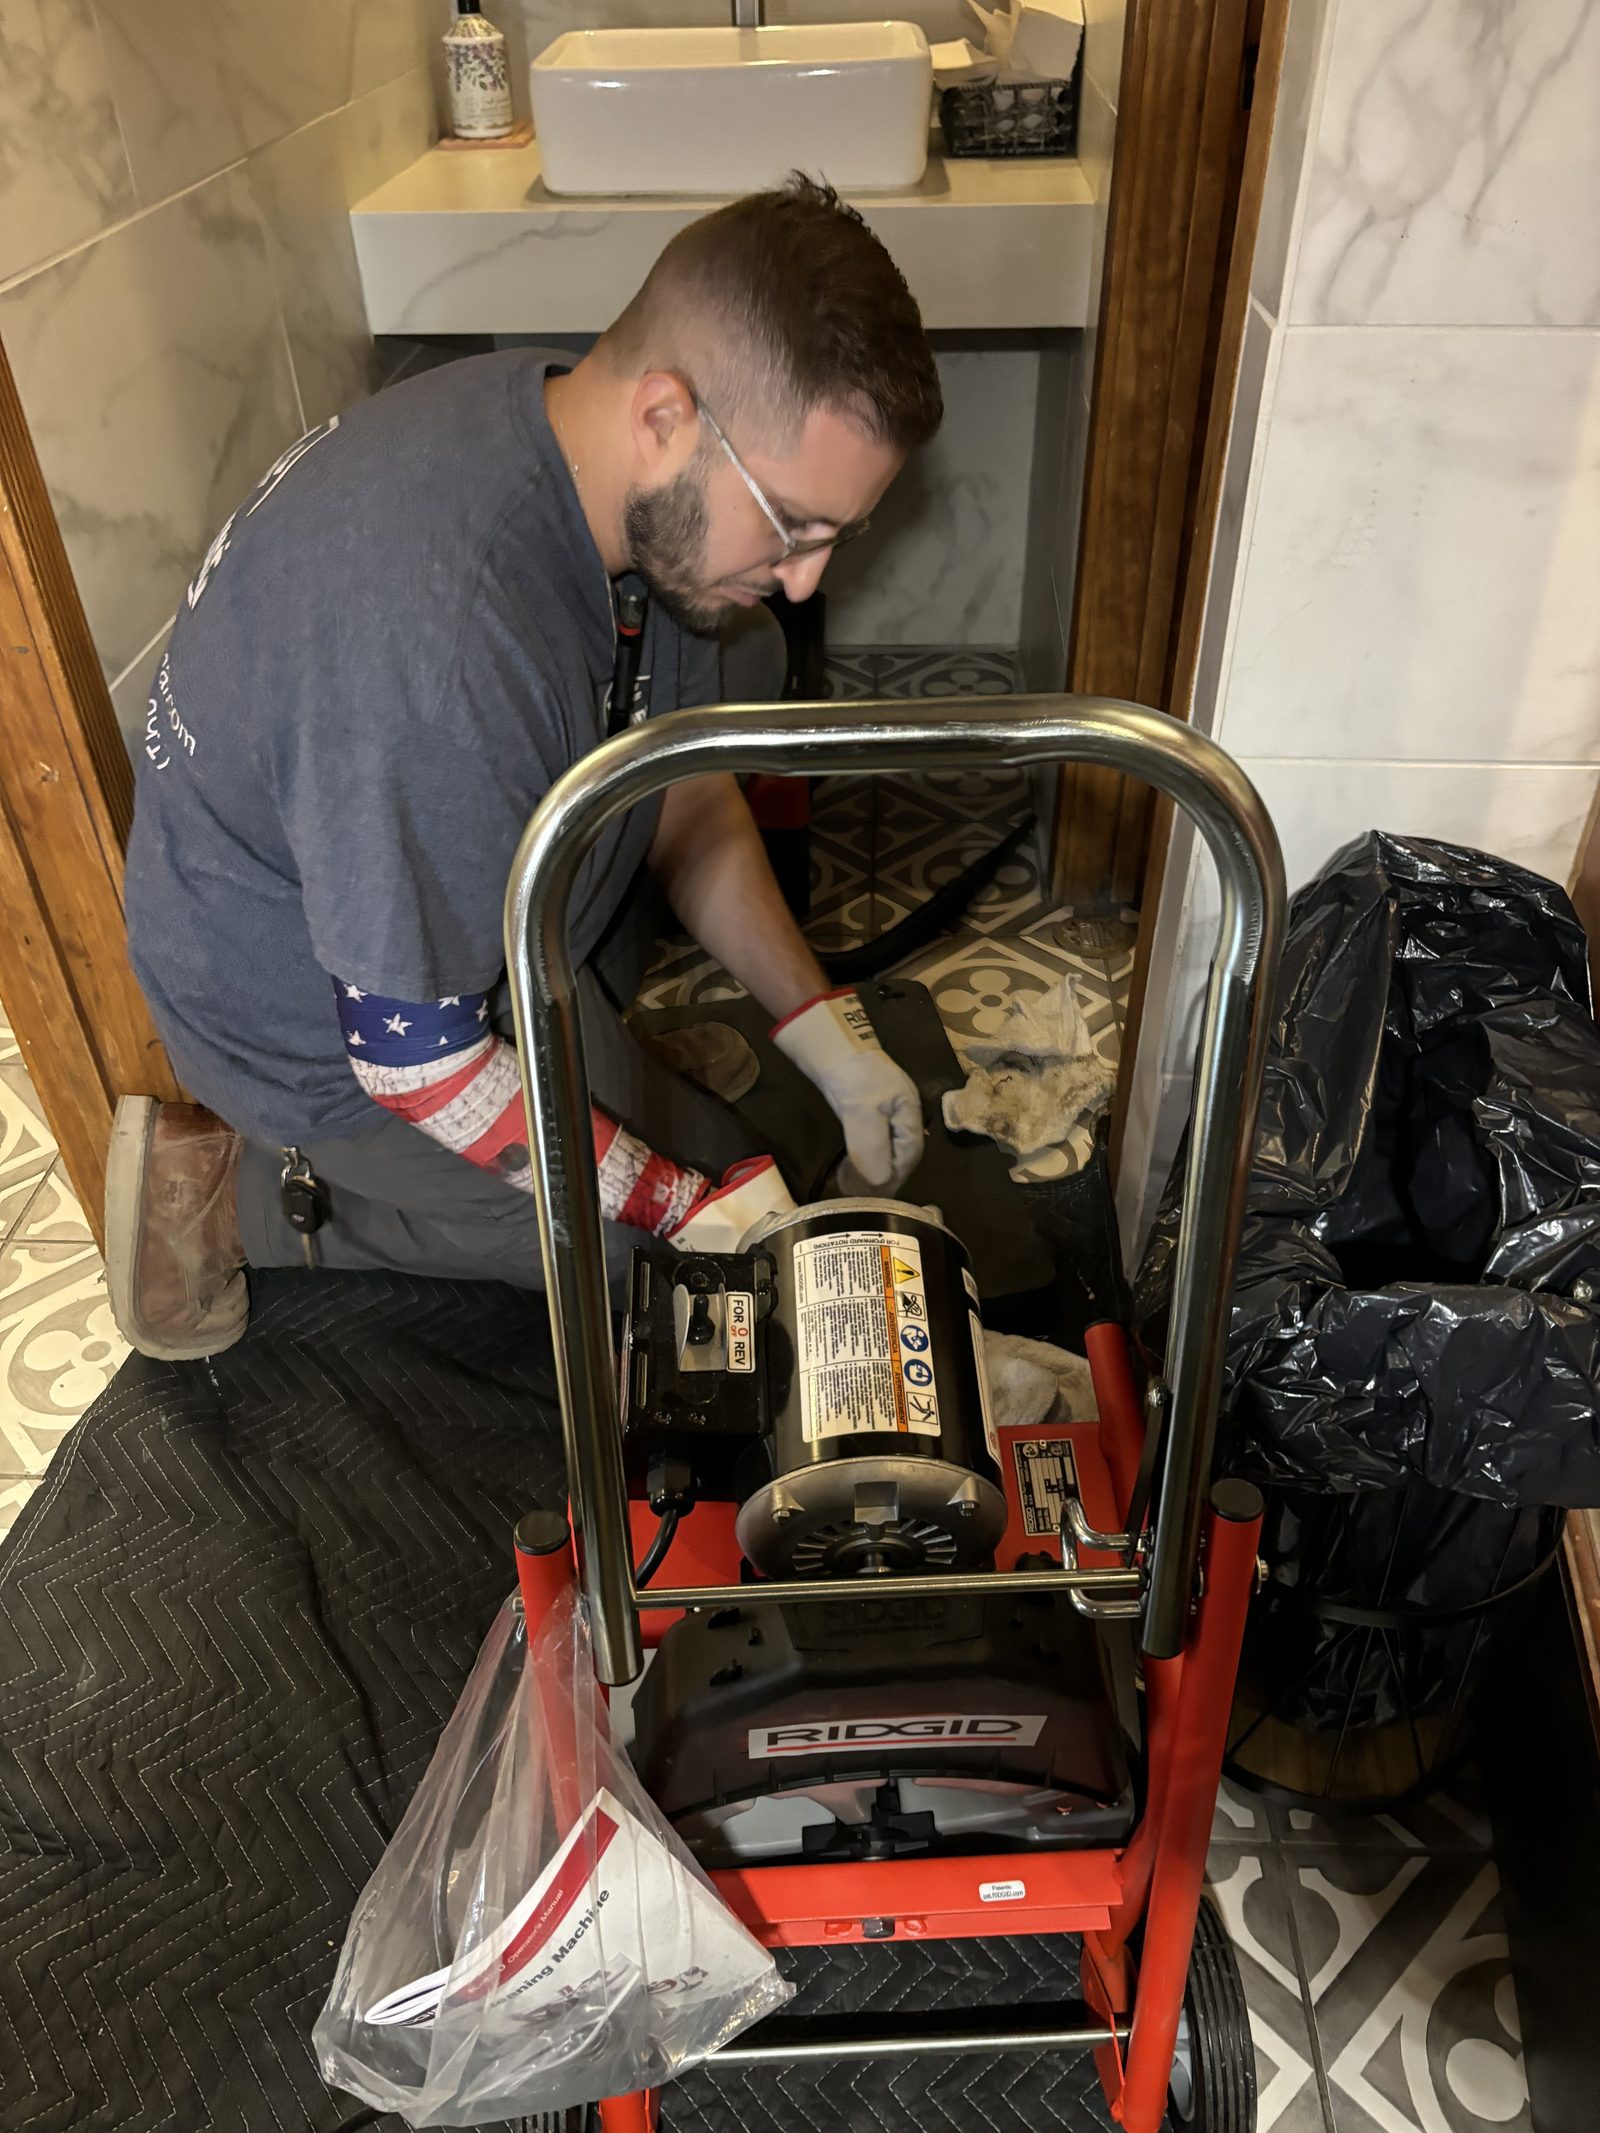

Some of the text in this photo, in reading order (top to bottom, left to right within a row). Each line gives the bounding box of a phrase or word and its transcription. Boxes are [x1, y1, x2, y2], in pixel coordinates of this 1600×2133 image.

[733, 1299, 744, 1323] FOR
[734, 1341, 746, 1365] REV
[766, 1718, 1024, 1747] RIDGID
[507, 1921, 543, 1964] Operator's
[539, 1888, 564, 1923] Manual
